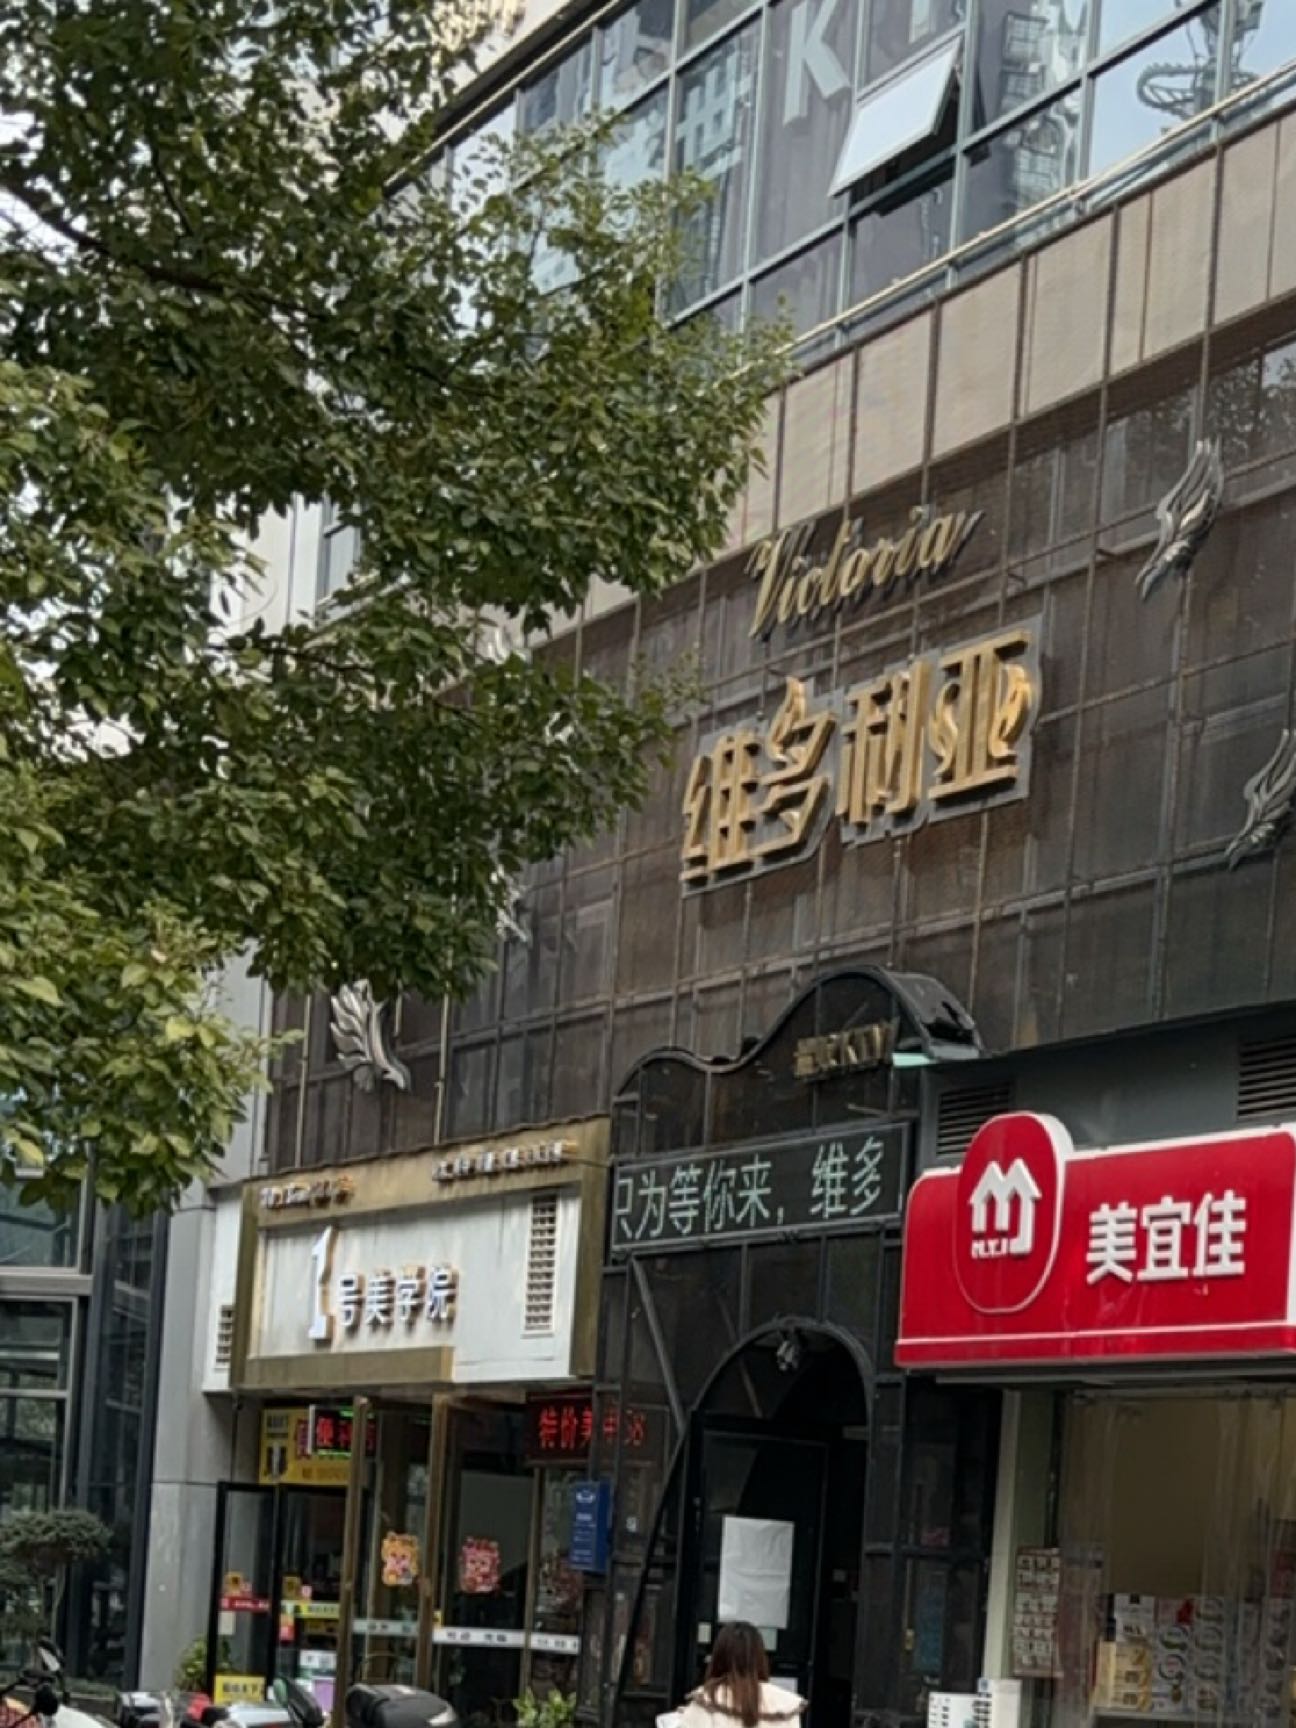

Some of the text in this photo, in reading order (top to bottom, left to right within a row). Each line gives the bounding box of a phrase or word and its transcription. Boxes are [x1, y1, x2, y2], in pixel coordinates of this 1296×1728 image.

[745, 505, 985, 640] Victoria
[680, 630, 1033, 882] 维多利亚
[811, 1137, 884, 1219] 维多
[1086, 1189, 1247, 1285] 美宜佳
